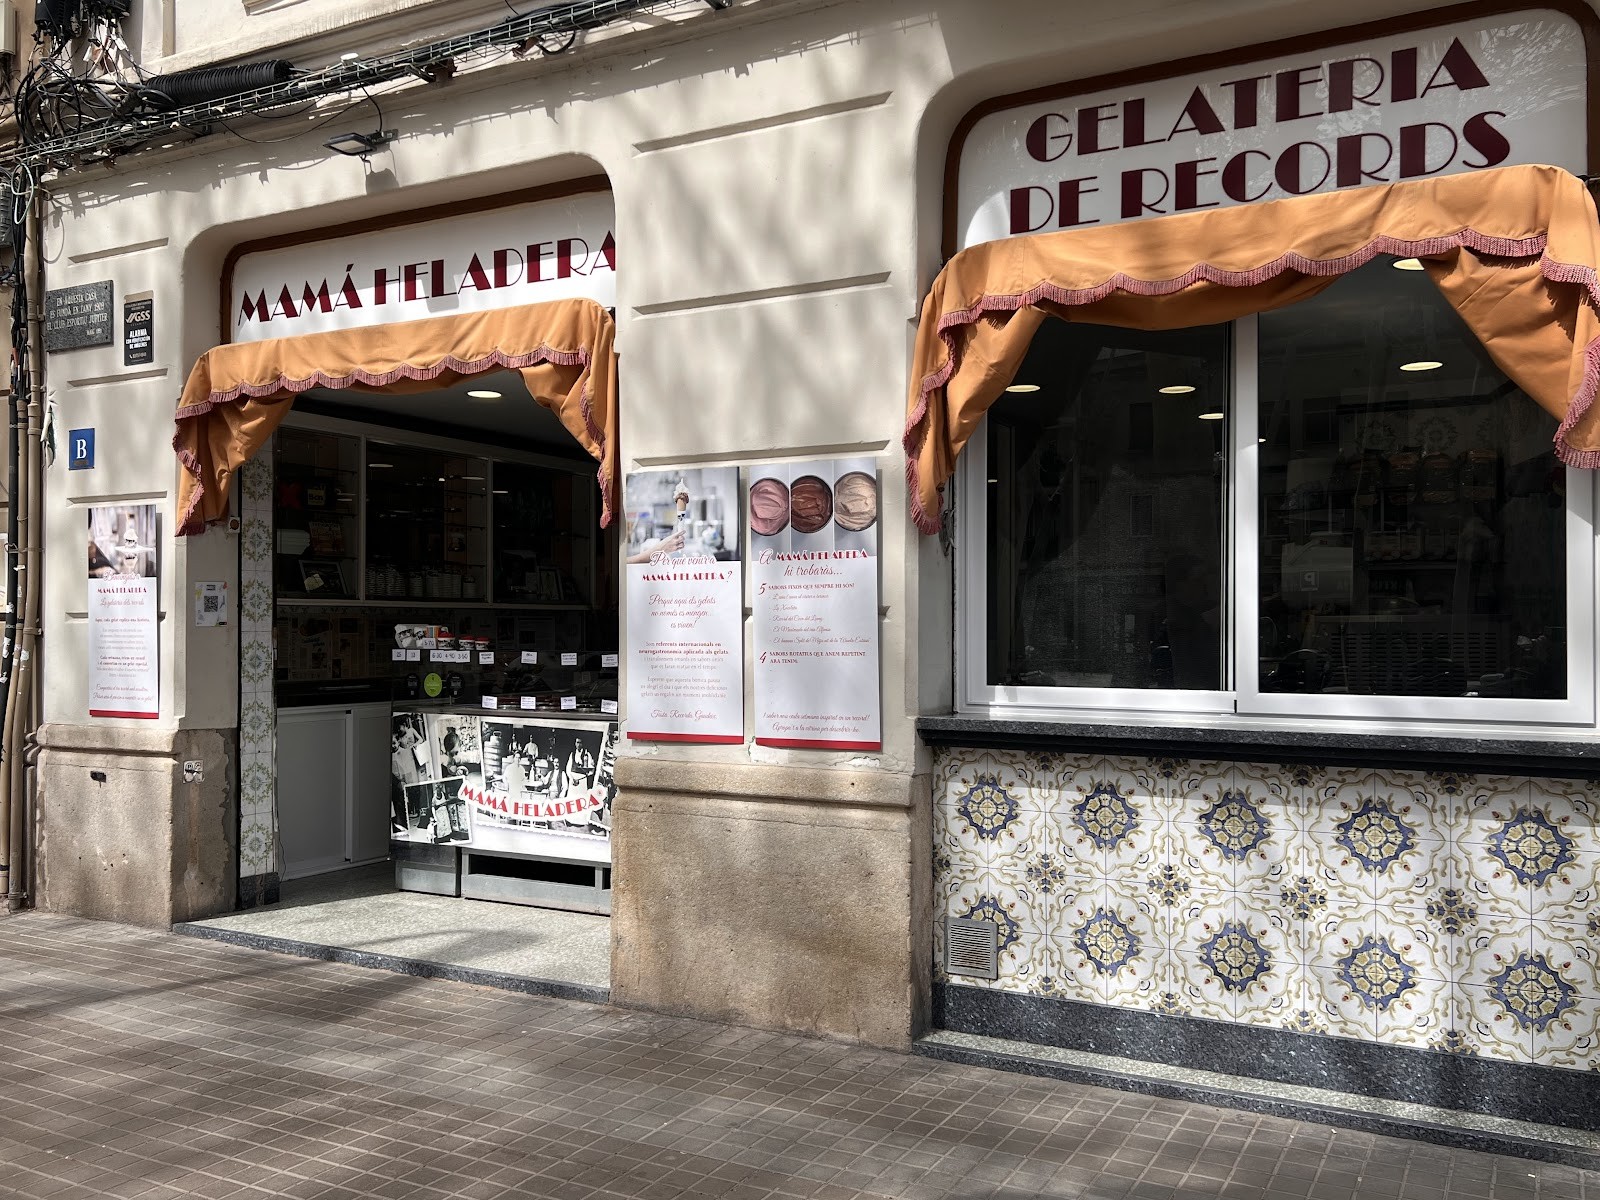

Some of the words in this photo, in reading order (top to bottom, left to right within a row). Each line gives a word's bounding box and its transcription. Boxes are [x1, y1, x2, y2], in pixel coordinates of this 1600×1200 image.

[1026, 36, 1490, 162] GELATERIA
[1010, 176, 1100, 235] DE
[1121, 110, 1511, 219] RECORDS
[238, 263, 363, 326] MAMÁ
[375, 230, 616, 305] HELADERA
[130, 328, 148, 338] ALARMA
[76, 438, 87, 459] B
[776, 550, 808, 561] MAMÁ
[642, 571, 671, 581] MAMÁ
[784, 565, 793, 577] hi
[758, 583, 767, 596] 5
[760, 651, 767, 664] 4
[461, 785, 508, 813] MAMÁ
[514, 794, 600, 817] HELADERA
